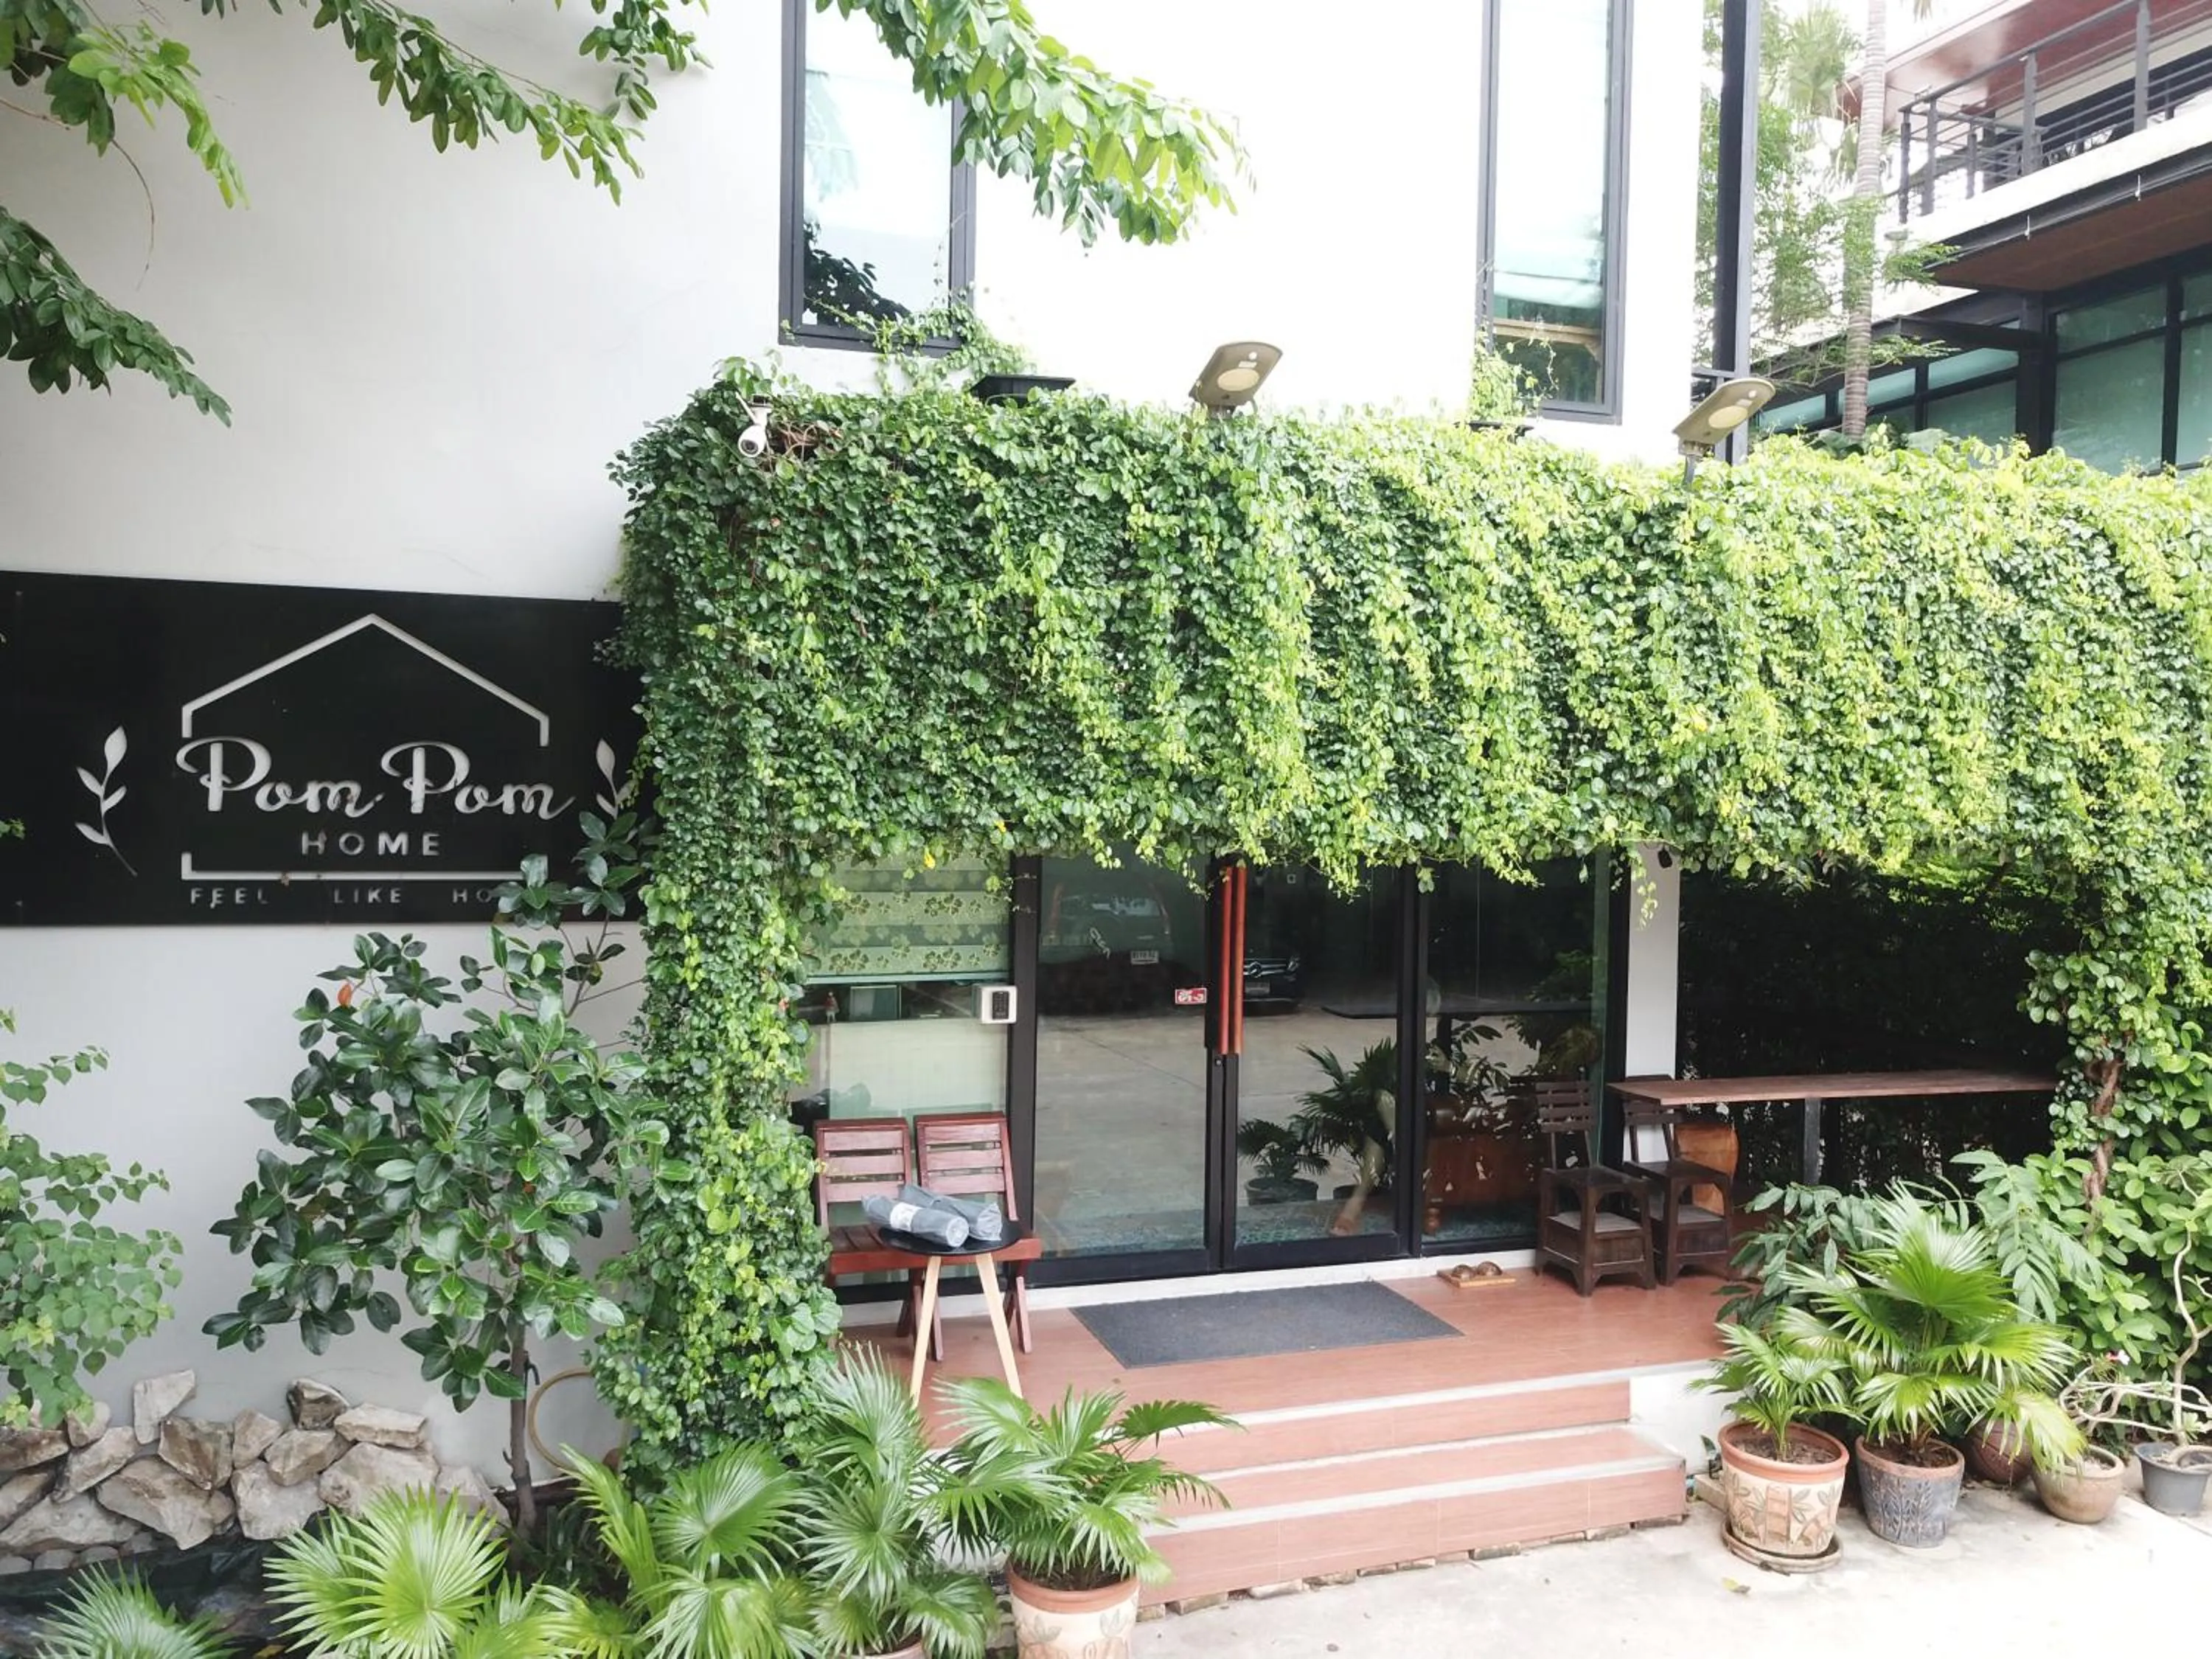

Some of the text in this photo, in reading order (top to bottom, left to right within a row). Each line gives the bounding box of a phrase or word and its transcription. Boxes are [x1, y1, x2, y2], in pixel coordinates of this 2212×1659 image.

[175, 737, 576, 820] Pom Pom
[302, 831, 440, 856] HOME
[190, 888, 493, 904] FEEL LIKE HO
